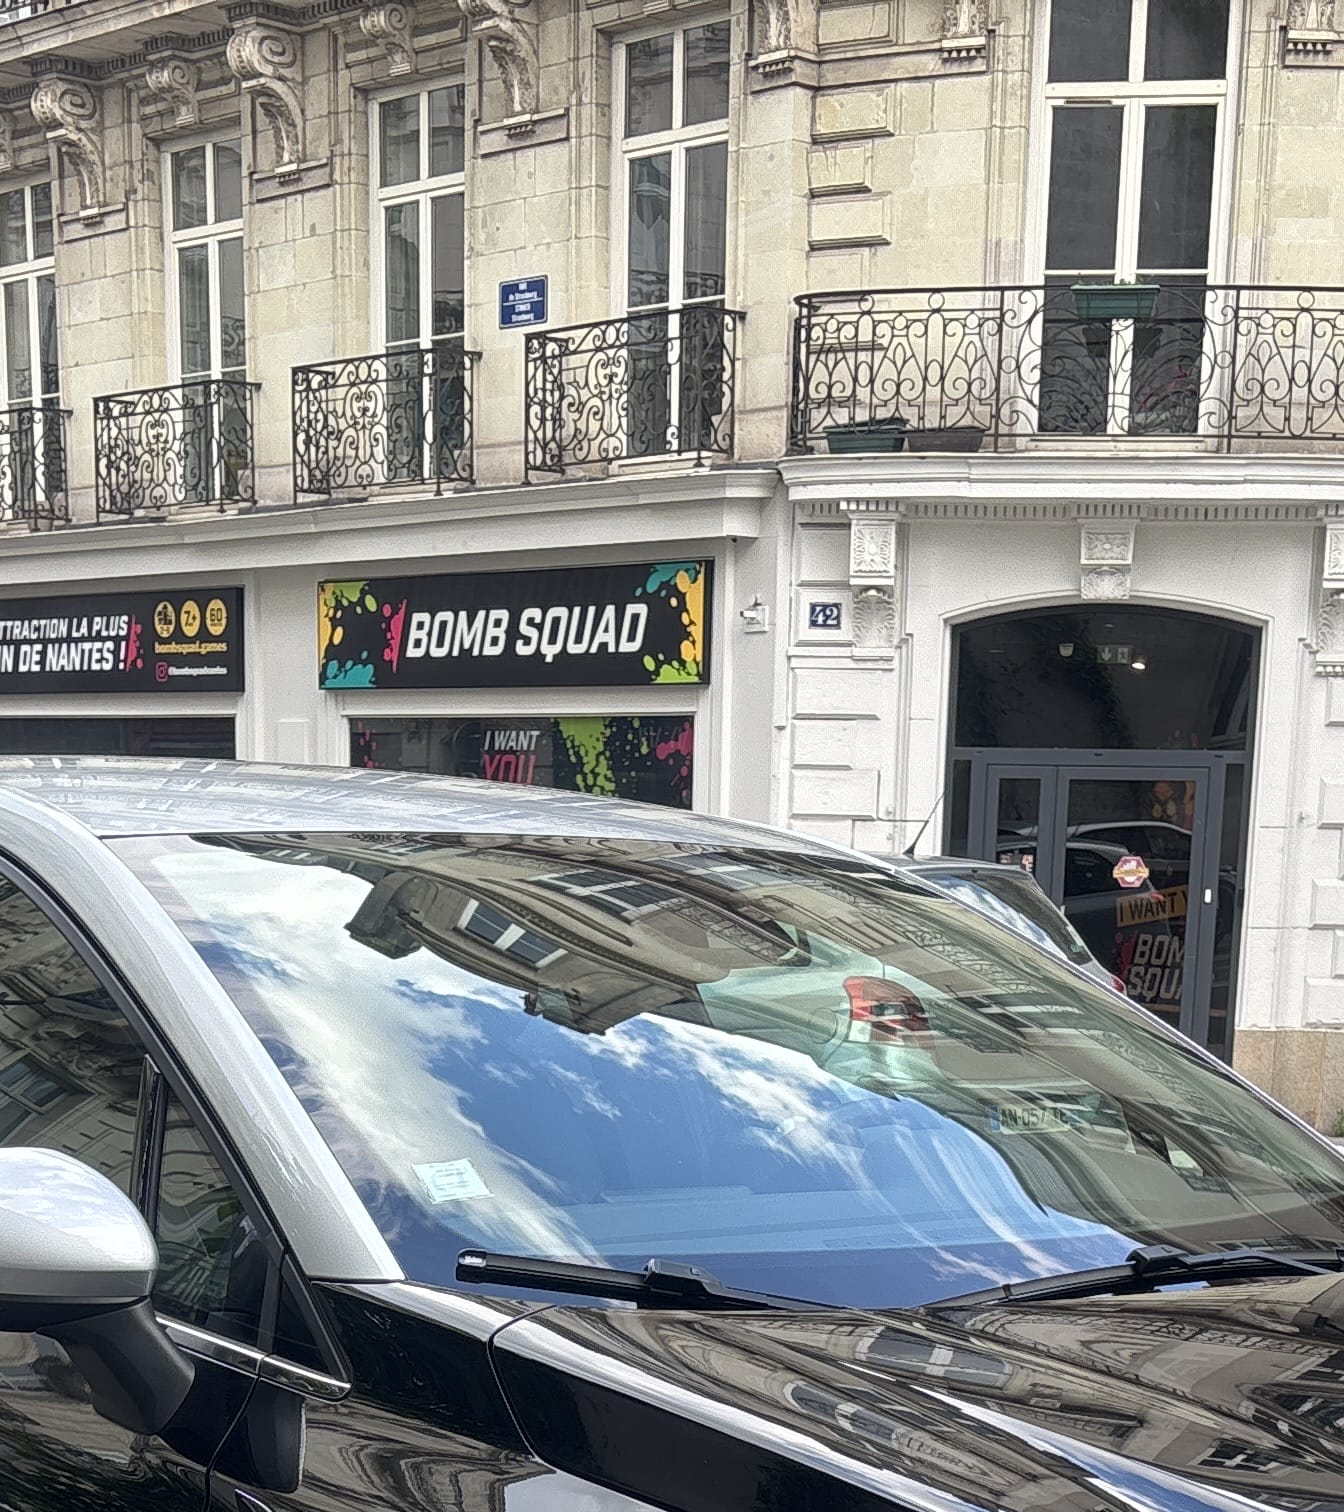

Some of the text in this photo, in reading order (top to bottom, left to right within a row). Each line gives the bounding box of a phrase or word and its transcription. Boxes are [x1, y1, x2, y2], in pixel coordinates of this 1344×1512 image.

[71, 616, 89, 639] LA
[92, 615, 129, 638] PLUS
[811, 606, 838, 625] 42
[406, 603, 649, 663] BOMB SQUAD
[18, 643, 43, 672] DE
[45, 641, 114, 673] NANTES
[118, 640, 127, 670] !
[484, 730, 542, 751] I WANT
[1129, 891, 1178, 919] WANT
[1134, 932, 1186, 967] BOM
[1127, 965, 1185, 1002] SQU
